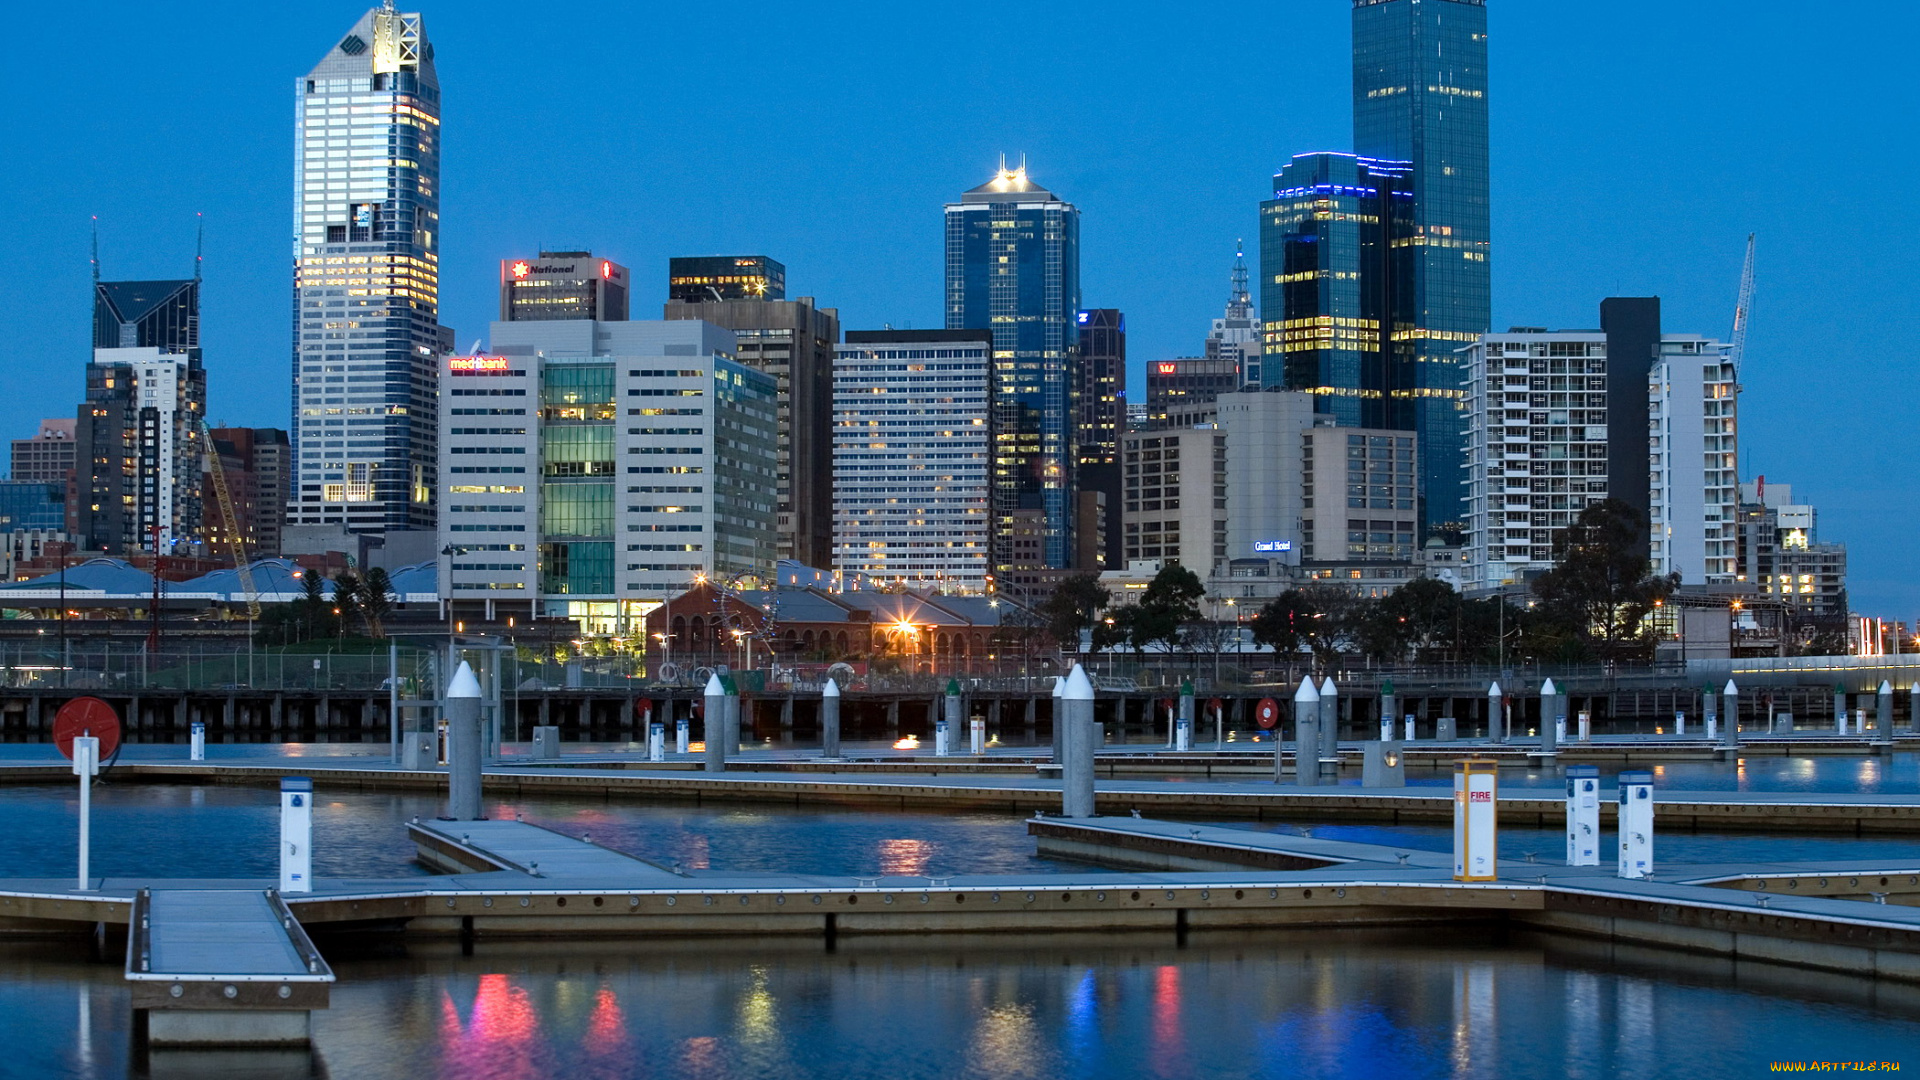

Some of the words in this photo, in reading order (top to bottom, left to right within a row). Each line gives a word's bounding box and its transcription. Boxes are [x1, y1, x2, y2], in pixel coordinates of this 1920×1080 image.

[530, 264, 575, 274] National
[450, 356, 507, 370] medibank
[1254, 541, 1273, 551] Grand
[1274, 540, 1291, 551] Hotel
[1470, 791, 1491, 799] FIRE
